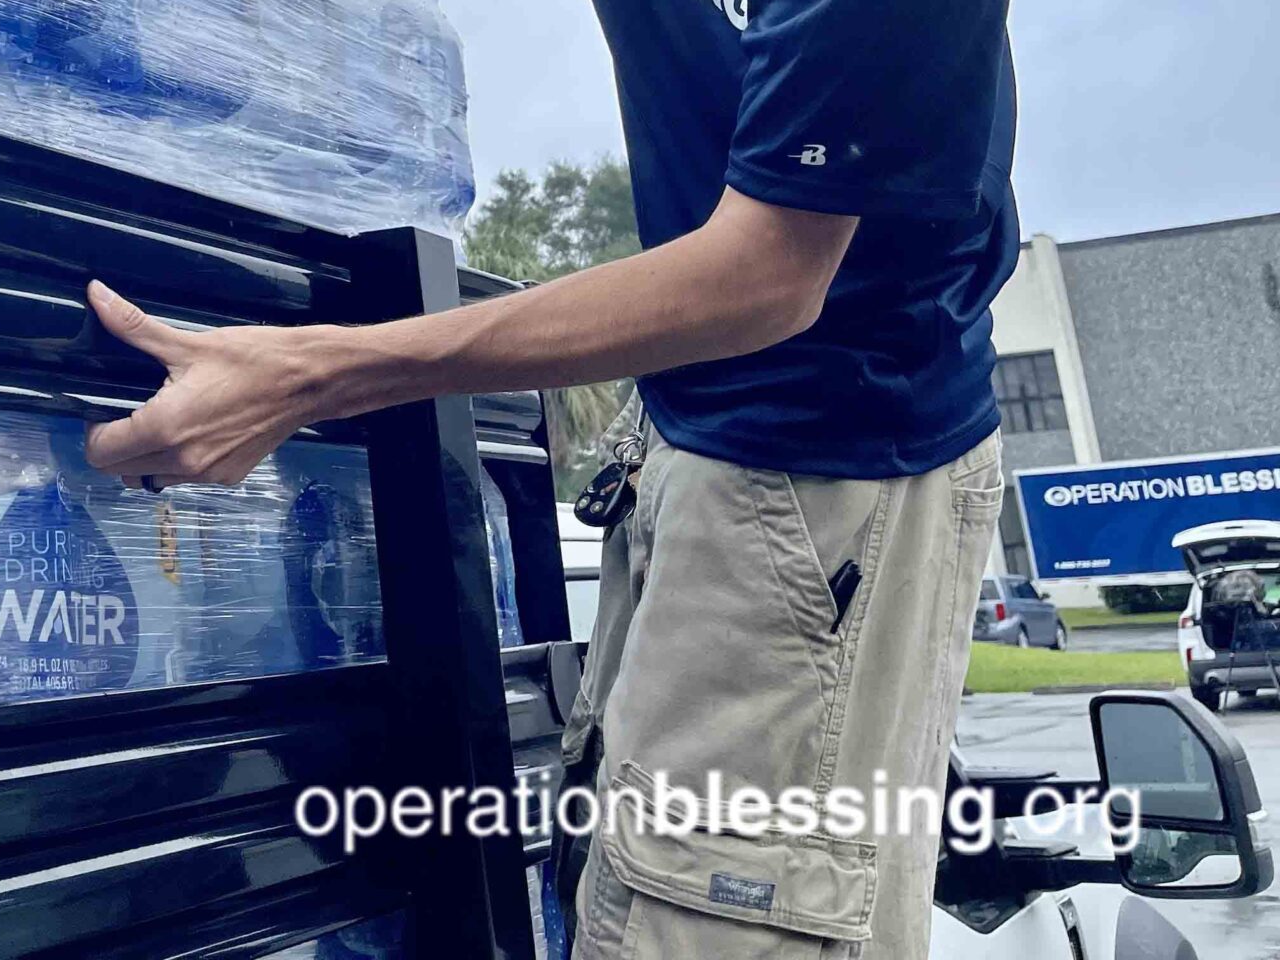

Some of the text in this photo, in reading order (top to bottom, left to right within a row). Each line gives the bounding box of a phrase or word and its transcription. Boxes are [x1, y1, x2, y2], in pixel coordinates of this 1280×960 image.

[1044, 476, 1186, 507] OPERATION
[40, 658, 49, 672] FL
[51, 658, 61, 672] OZ
